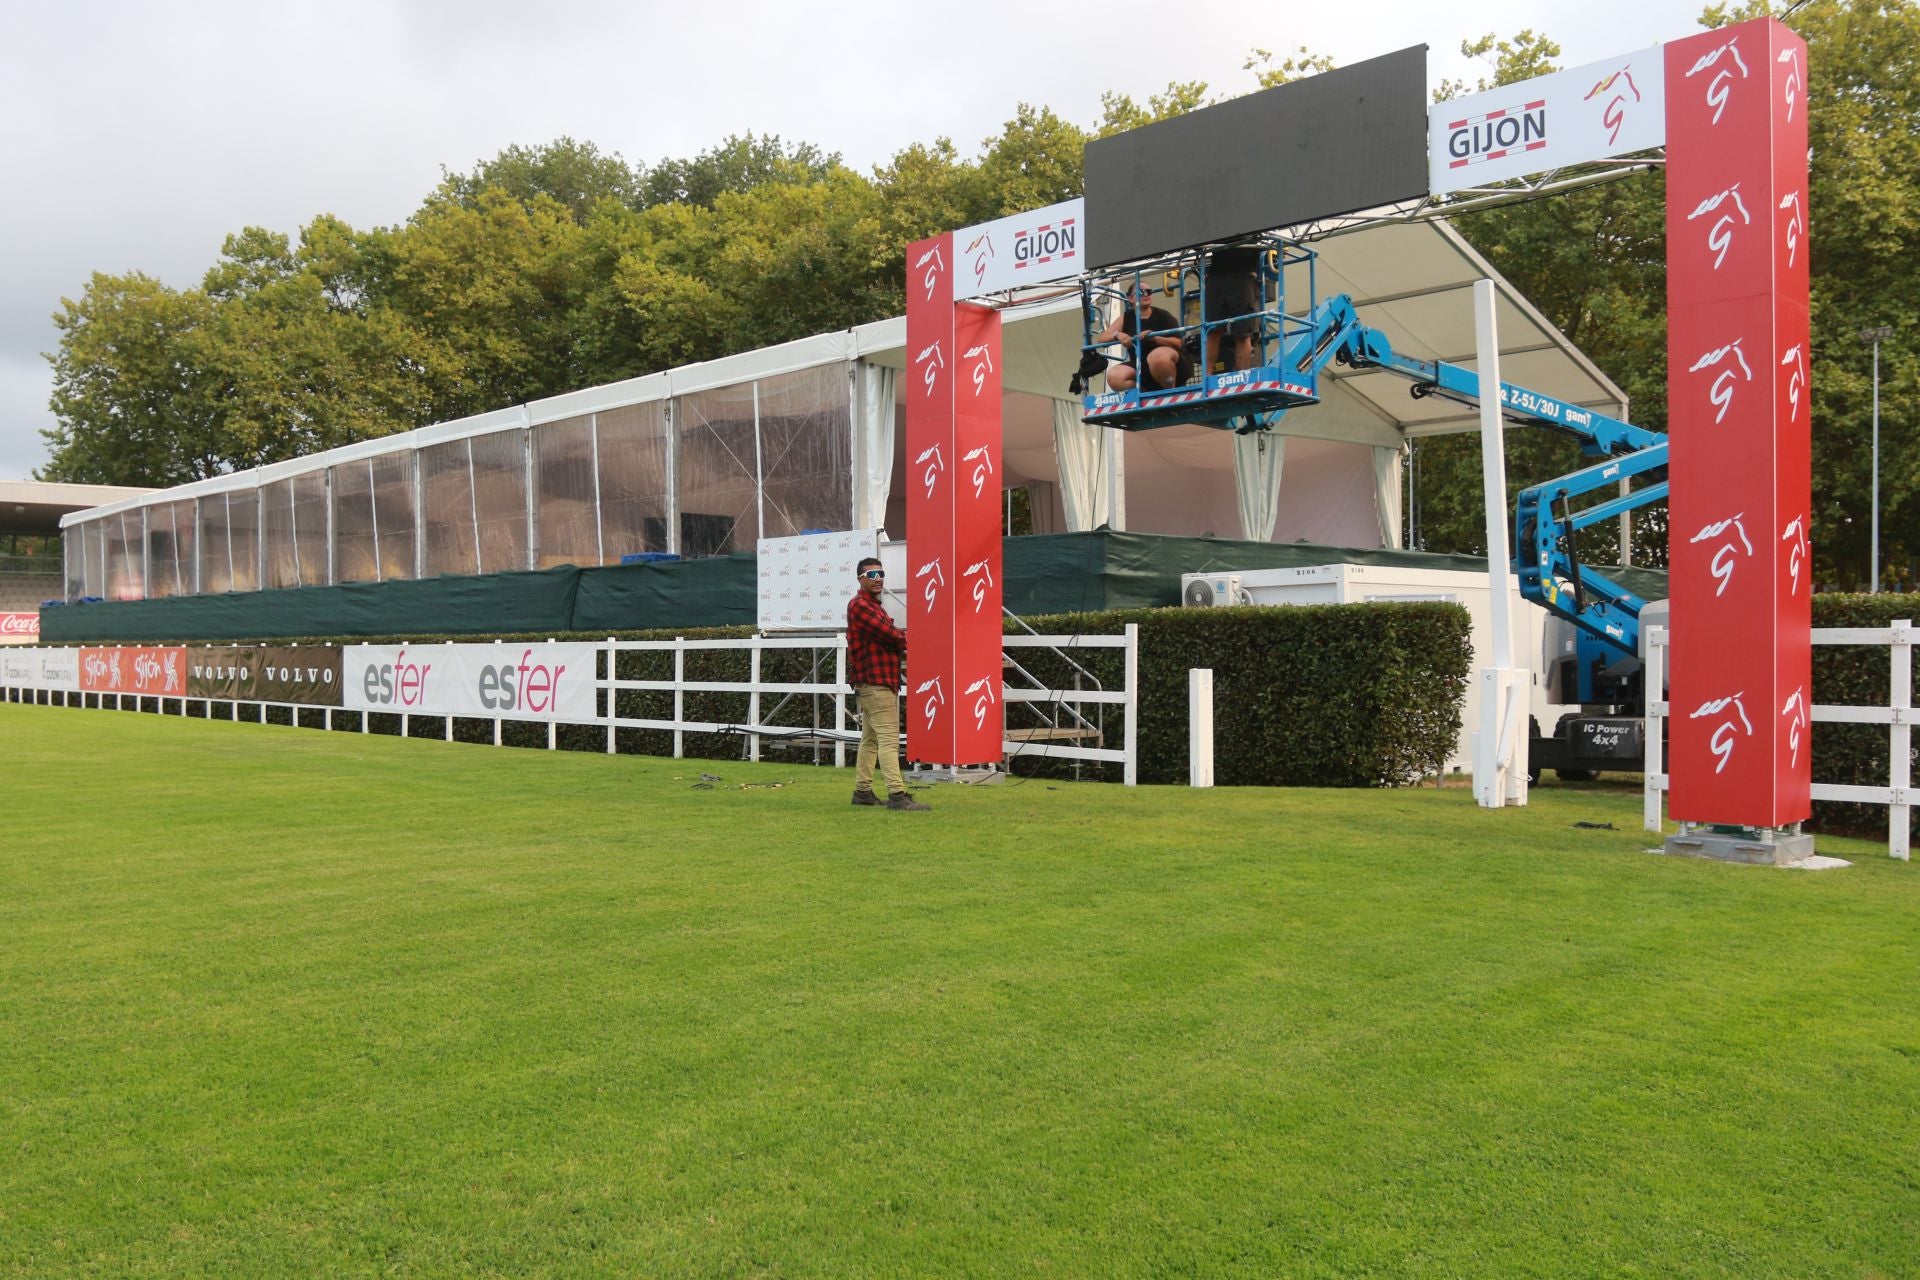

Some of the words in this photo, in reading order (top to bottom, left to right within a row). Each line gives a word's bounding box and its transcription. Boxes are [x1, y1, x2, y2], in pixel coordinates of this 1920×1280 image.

[1449, 110, 1545, 158] GIJON
[1015, 226, 1075, 261] GIJON
[1510, 390, 1560, 418] Z-51/30J
[194, 666, 248, 680] VOLVO
[266, 667, 333, 683] VOLVO
[364, 650, 431, 706] esfer
[479, 649, 566, 712] esfer
[1583, 724, 1595, 733] IC
[1597, 724, 1630, 734] Power
[1592, 734, 1619, 745] 4x4
